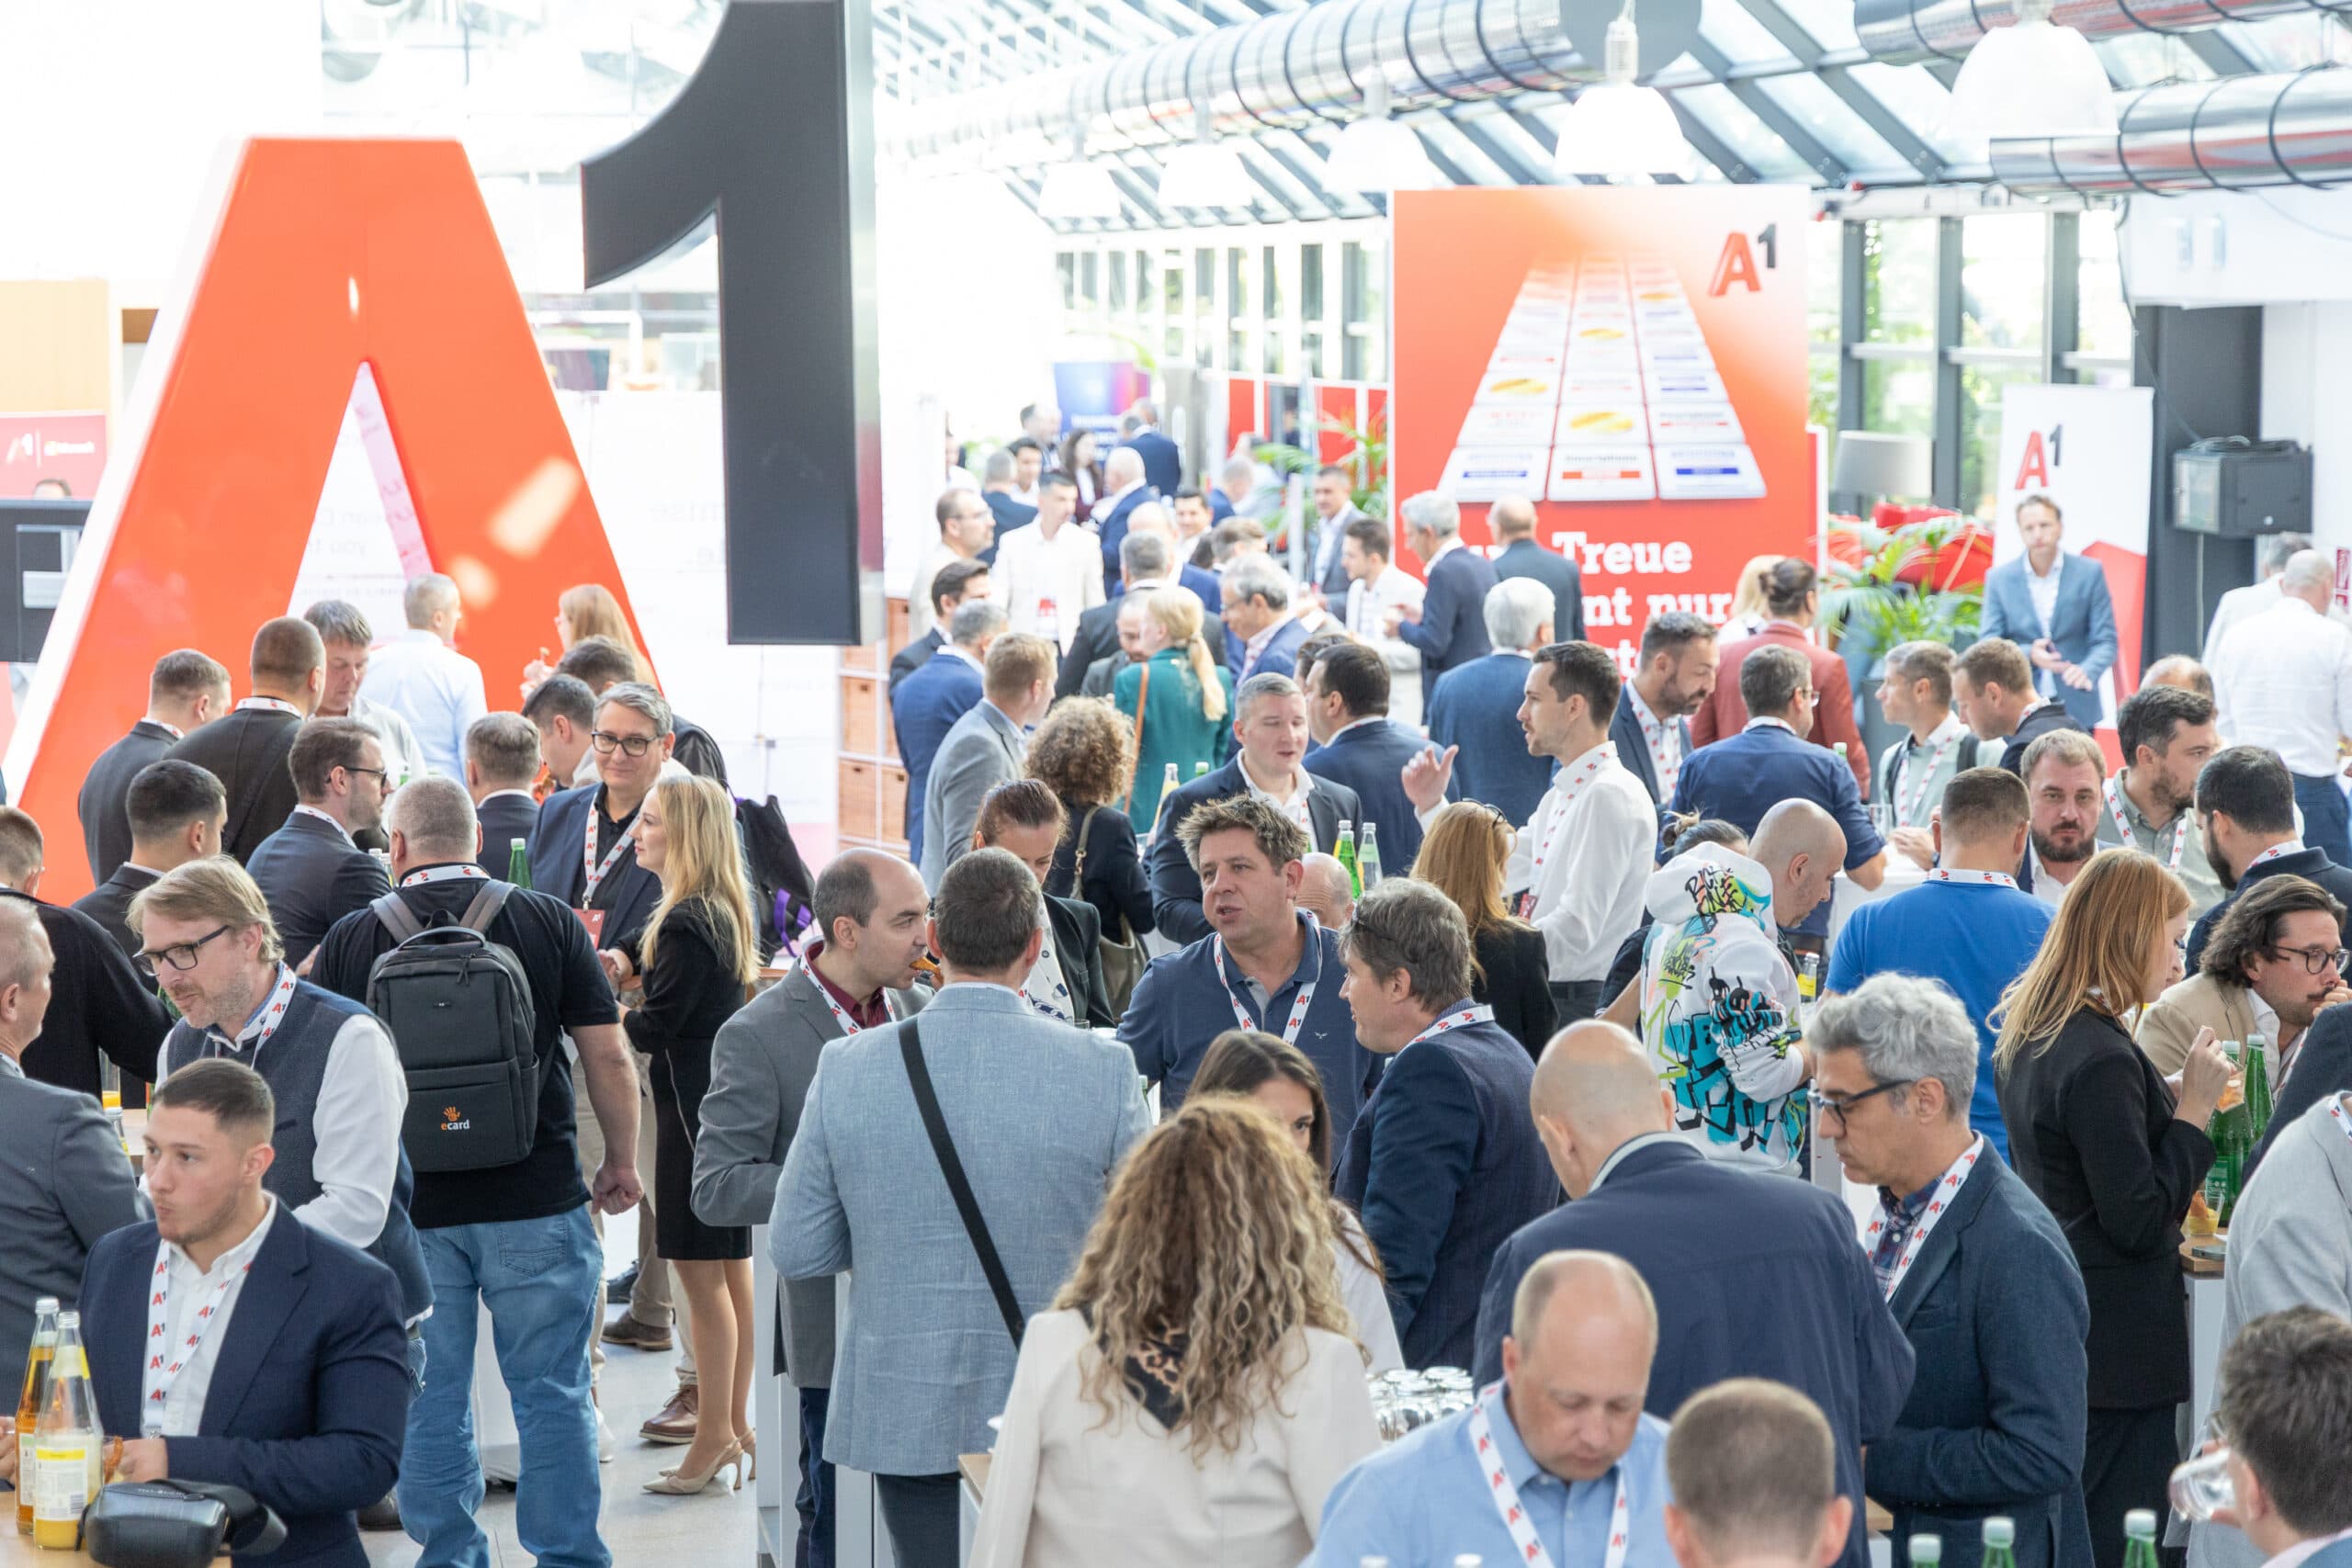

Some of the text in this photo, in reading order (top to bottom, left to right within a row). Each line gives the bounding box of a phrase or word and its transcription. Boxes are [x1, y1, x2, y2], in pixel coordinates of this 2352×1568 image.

[1707, 223, 1777, 298] A1
[2015, 423, 2063, 490] A1
[1552, 531, 1692, 574] Treue
[1646, 593, 1733, 625] nur
[280, 981, 294, 990] A1
[1296, 994, 1310, 1005] A1
[272, 1002, 286, 1013] A1
[1242, 1017, 1253, 1029] A1
[1289, 1017, 1302, 1028] A1
[1462, 1012, 1477, 1022] A1
[441, 1119, 469, 1130] ecard
[1945, 1174, 1964, 1188] A1
[1929, 1201, 1946, 1214] A1
[1868, 1221, 1883, 1234] A1
[1915, 1228, 1928, 1241] A1
[155, 1260, 167, 1275] A1
[1901, 1255, 1912, 1269] A1
[152, 1291, 166, 1305] A1
[198, 1305, 215, 1318] A1
[151, 1323, 165, 1337] A1
[186, 1334, 201, 1348] A1
[150, 1355, 164, 1369] A1
[168, 1362, 183, 1373] A1
[150, 1388, 166, 1402] A1
[1478, 1432, 1491, 1454] A1
[1493, 1467, 1506, 1489] A1
[1508, 1503, 1521, 1525] A1
[1611, 1533, 1626, 1548] A1
[1526, 1539, 1541, 1562] A1
